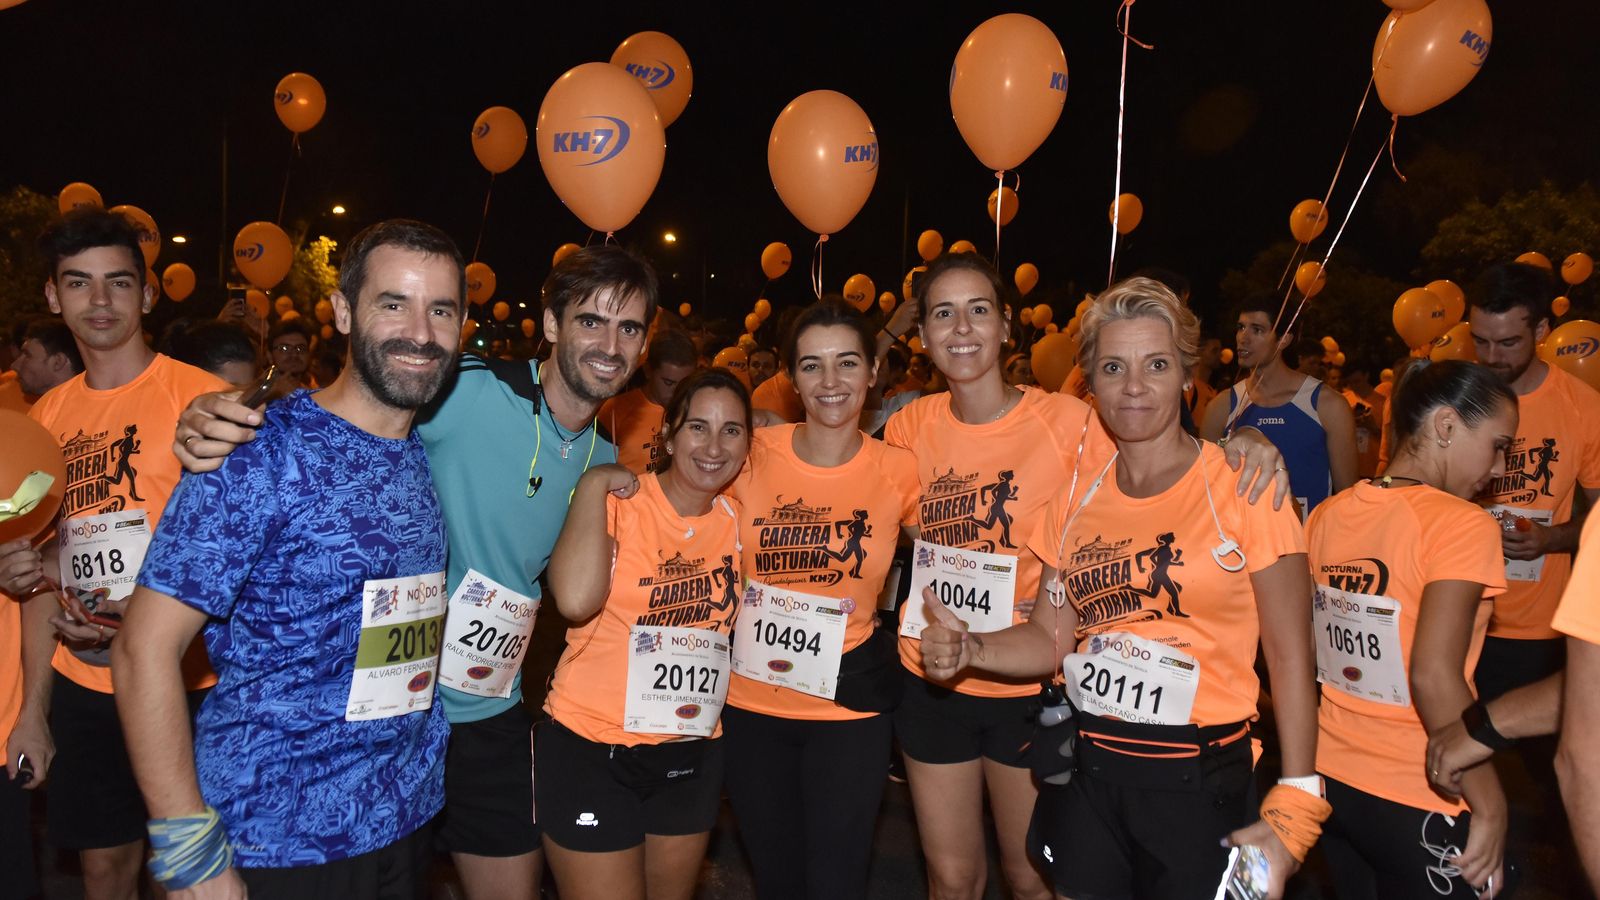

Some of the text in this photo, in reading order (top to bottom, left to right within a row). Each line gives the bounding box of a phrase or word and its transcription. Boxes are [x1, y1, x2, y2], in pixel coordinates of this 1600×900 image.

[67, 450, 107, 485] RRERA
[921, 492, 977, 525] CARRERA
[760, 524, 831, 549] CARRERA
[72, 549, 124, 580] 6818
[755, 549, 829, 572] NOCTURNA
[1321, 565, 1363, 574] NOCTURNA
[649, 575, 713, 609] CARRERA
[1068, 559, 1131, 601] CARRERA
[930, 579, 991, 615] 10044
[1079, 590, 1143, 626] NOCTURNA
[636, 603, 712, 627] NOCTURNA
[386, 620, 440, 663] 2013
[444, 642, 464, 657] RAUL
[459, 619, 528, 660] 20105
[753, 618, 821, 656] 10494
[1111, 639, 1150, 660] O8DO
[1326, 622, 1381, 661] 10618
[367, 660, 437, 680] ALVARO FERNANDE
[653, 663, 720, 694] 20127
[641, 693, 672, 702] ESTHER
[674, 695, 702, 704] JIMENEZ
[1080, 662, 1163, 714] 20111
[1098, 701, 1136, 721] CASTAÑO
